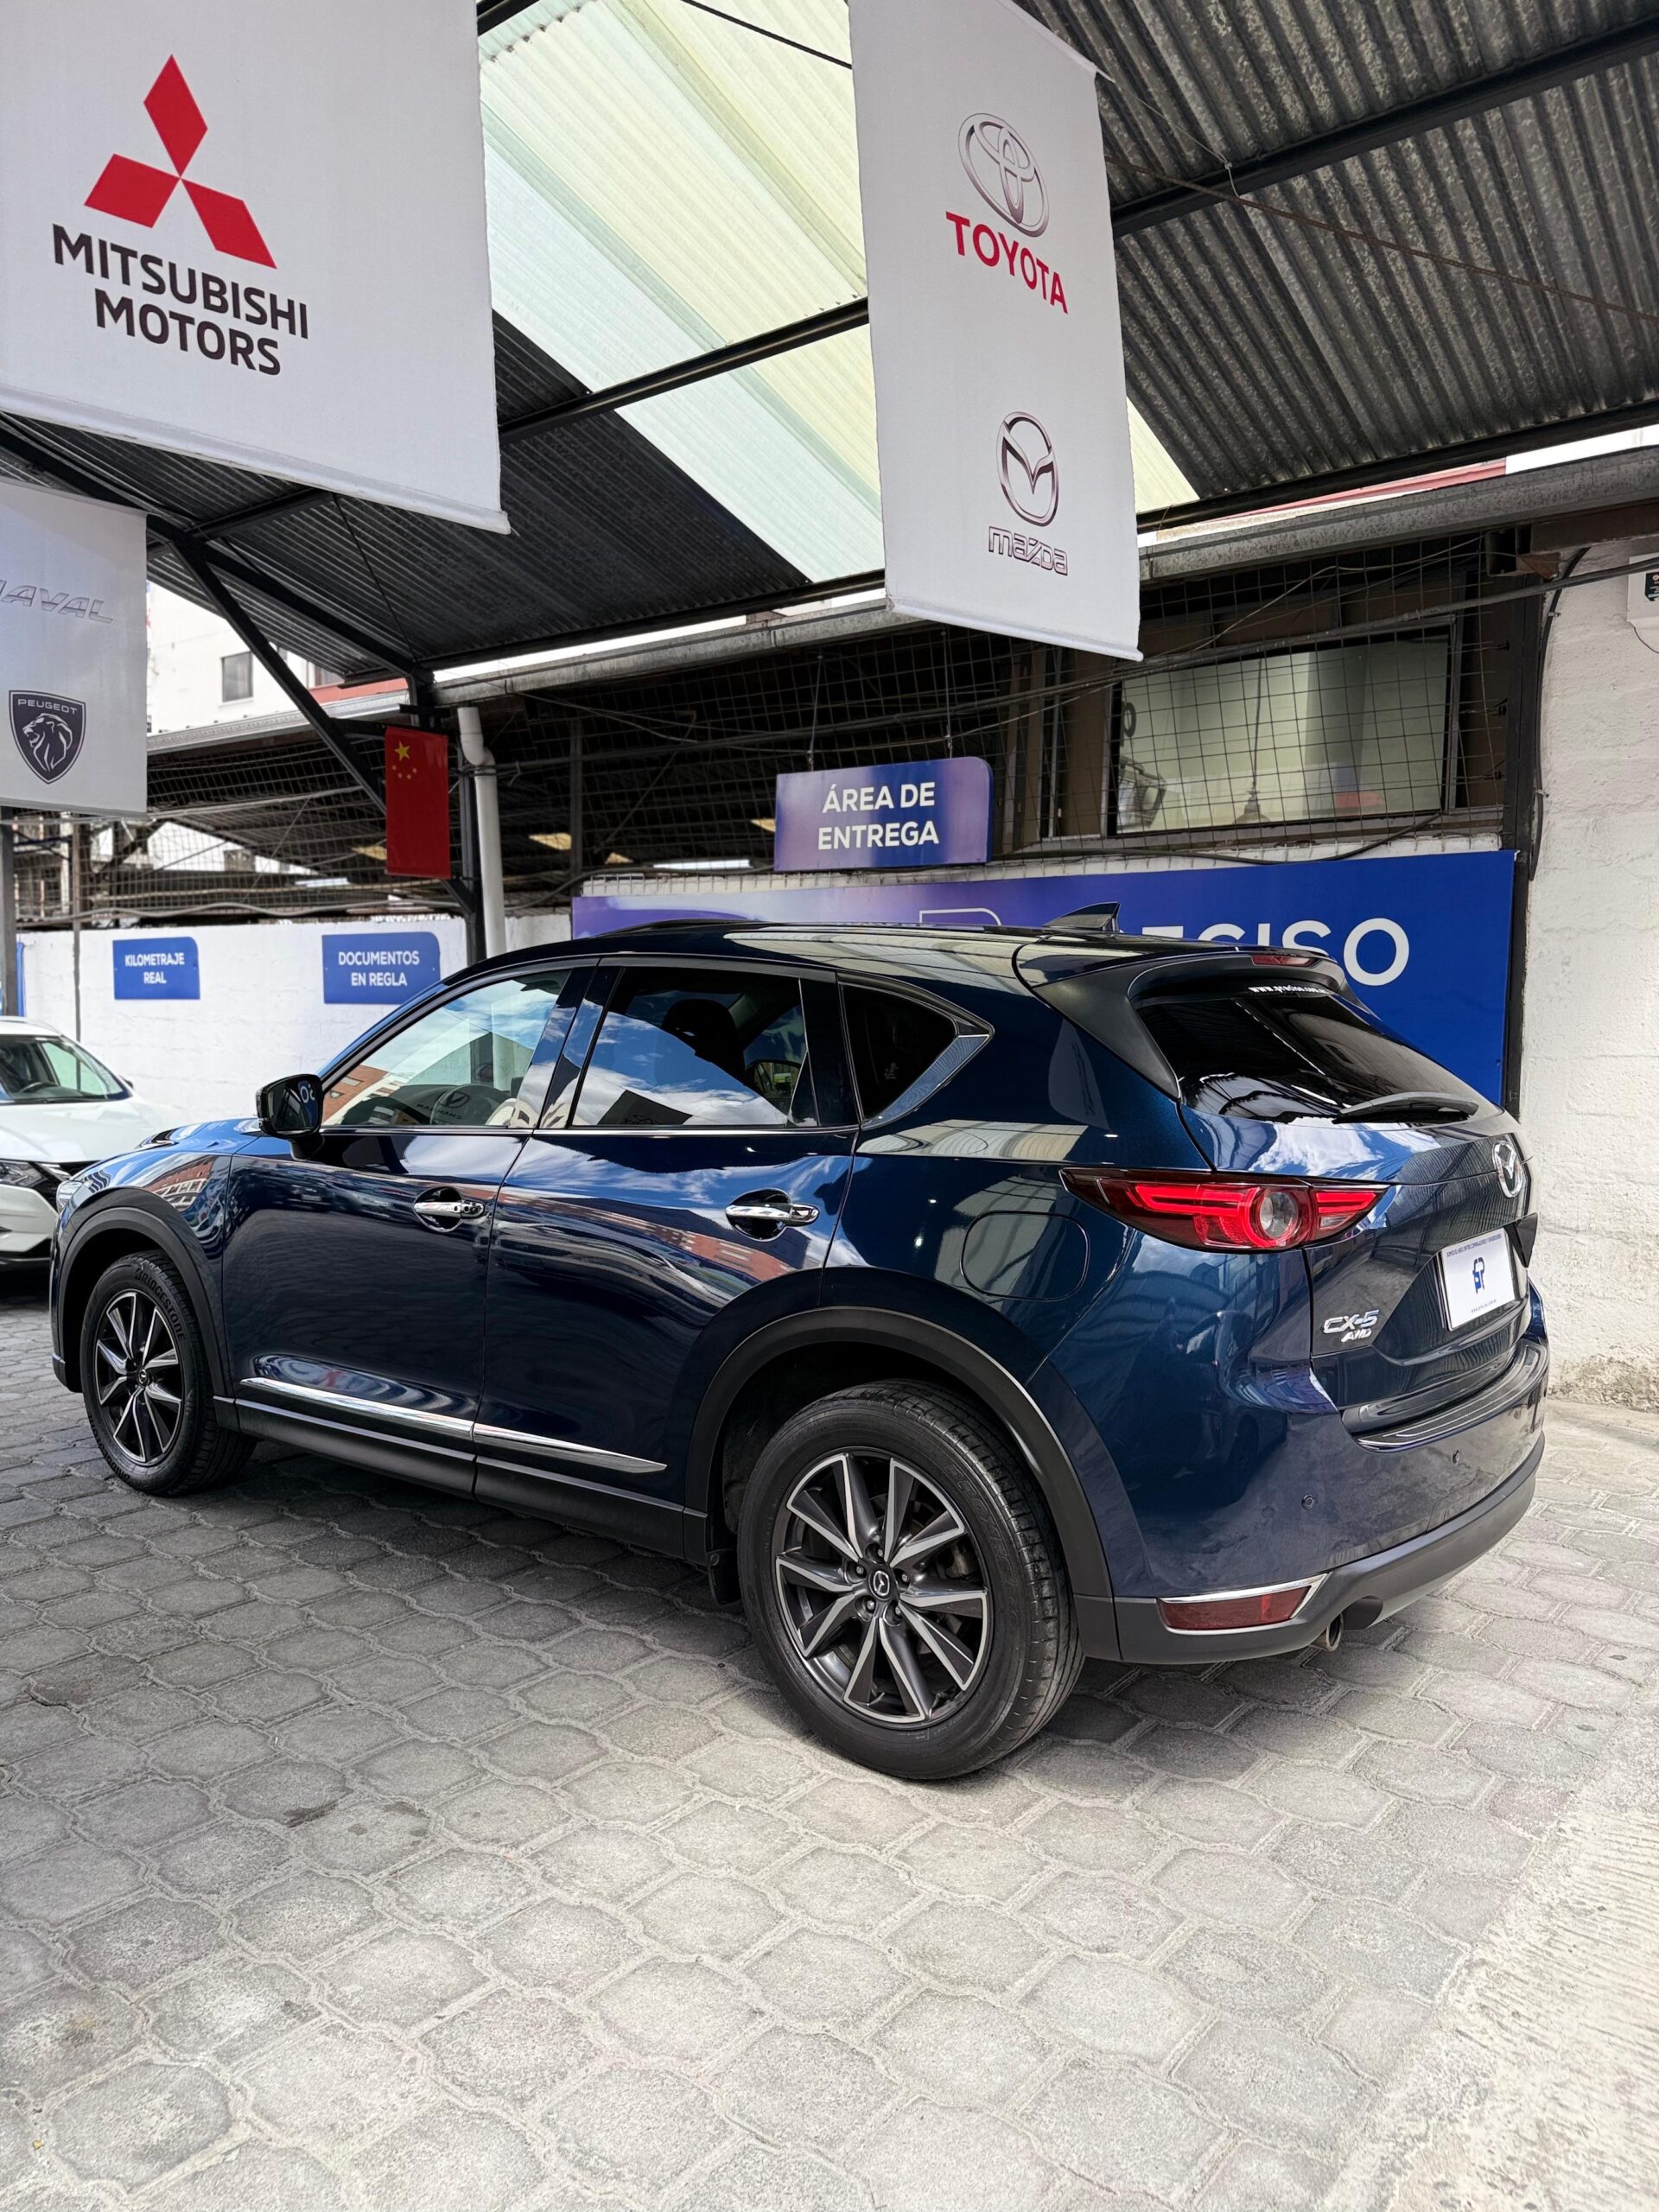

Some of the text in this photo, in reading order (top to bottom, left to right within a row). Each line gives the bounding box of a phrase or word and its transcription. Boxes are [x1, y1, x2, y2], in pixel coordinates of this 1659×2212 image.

[945, 211, 1069, 315] TOYOTA
[52, 223, 308, 340] MITSUBISHI
[95, 288, 282, 377] MOTORS
[17, 698, 78, 715] PEUGEOT
[823, 782, 936, 814] ÁREA DE
[817, 820, 940, 851] ENTREGA
[124, 952, 186, 968] KILOMETRAJE
[338, 950, 421, 967] DOCUMENTOS
[143, 971, 167, 985] REAL
[351, 971, 408, 987] EN REGLA
[134, 1268, 186, 1342] BRIDGESTONE
[1323, 1309, 1380, 1334] CX-5
[1341, 1328, 1372, 1343] AWD
